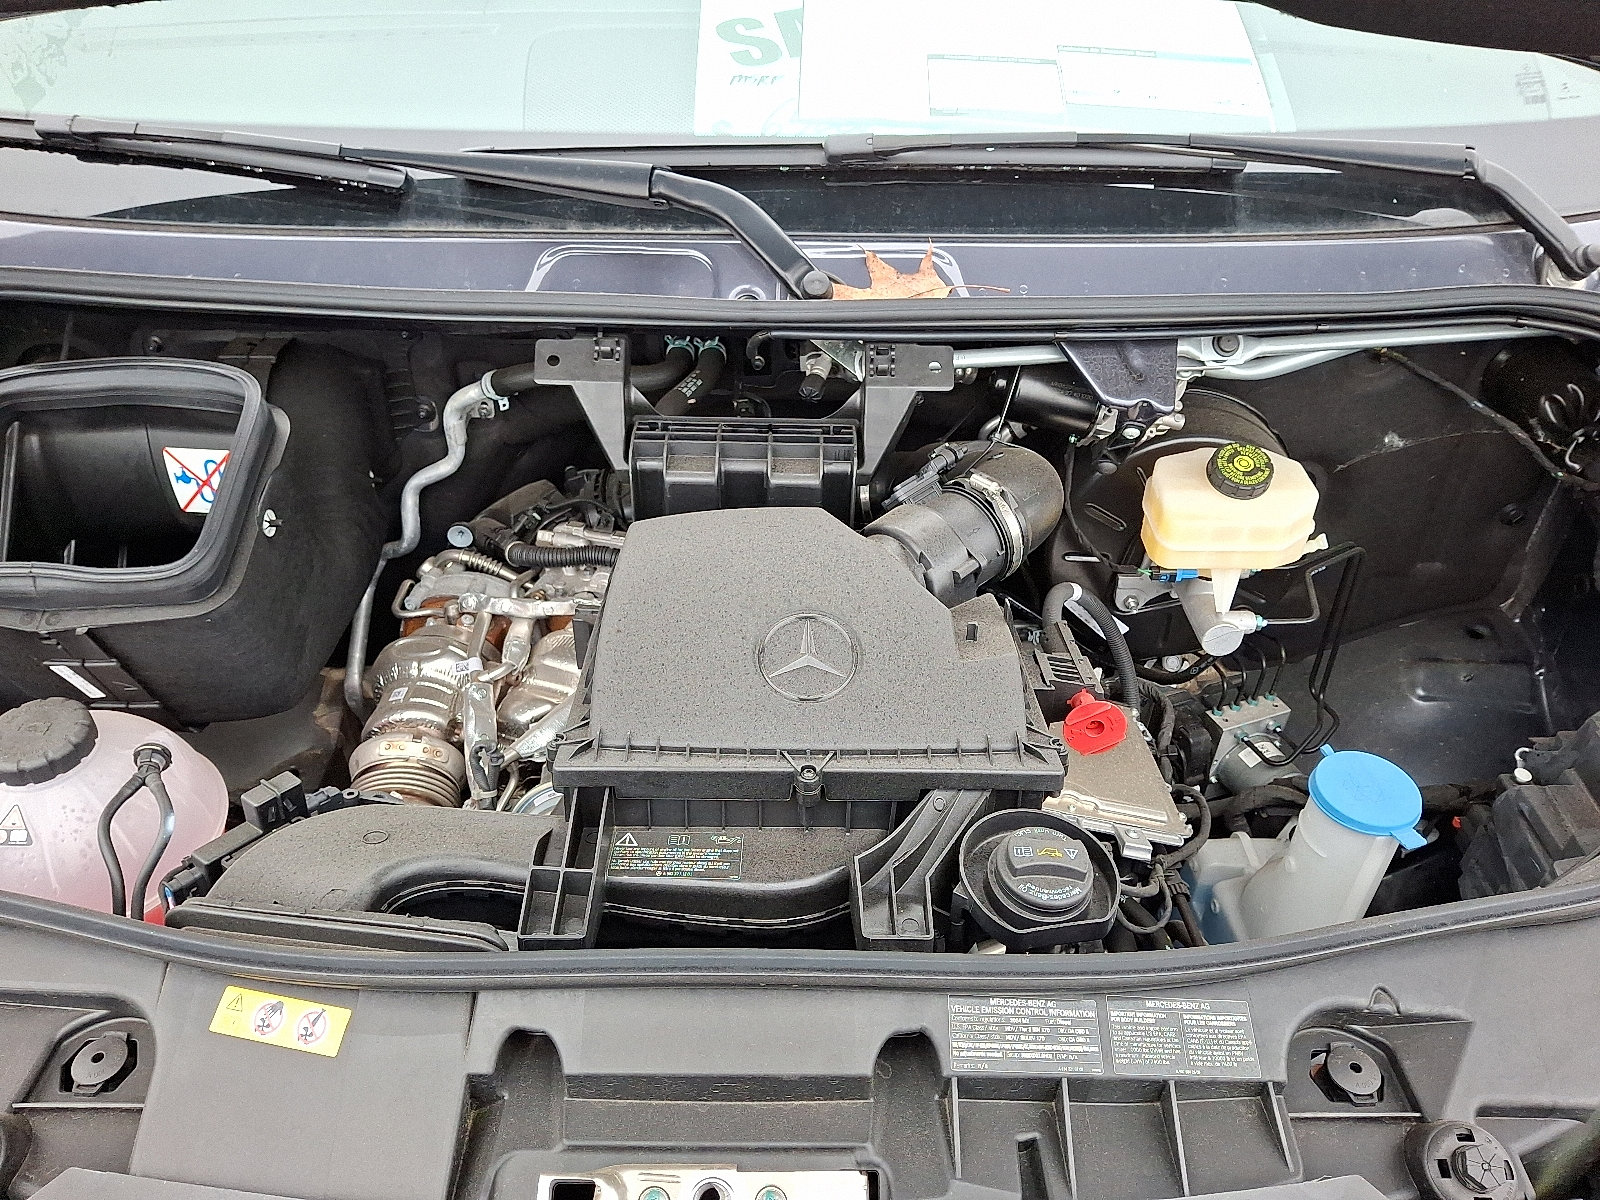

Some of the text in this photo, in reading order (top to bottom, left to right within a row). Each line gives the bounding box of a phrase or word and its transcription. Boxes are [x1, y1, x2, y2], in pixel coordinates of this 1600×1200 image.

[1018, 884, 1082, 900] Mercedes-Benz Oil
[990, 998, 1046, 1008] MERCEDES-BENZ
[1145, 1000, 1200, 1010] MERCEDES-BENZ
[951, 1005, 1096, 1018] VEHICLE EMISSION CONTROL INFORMATION
